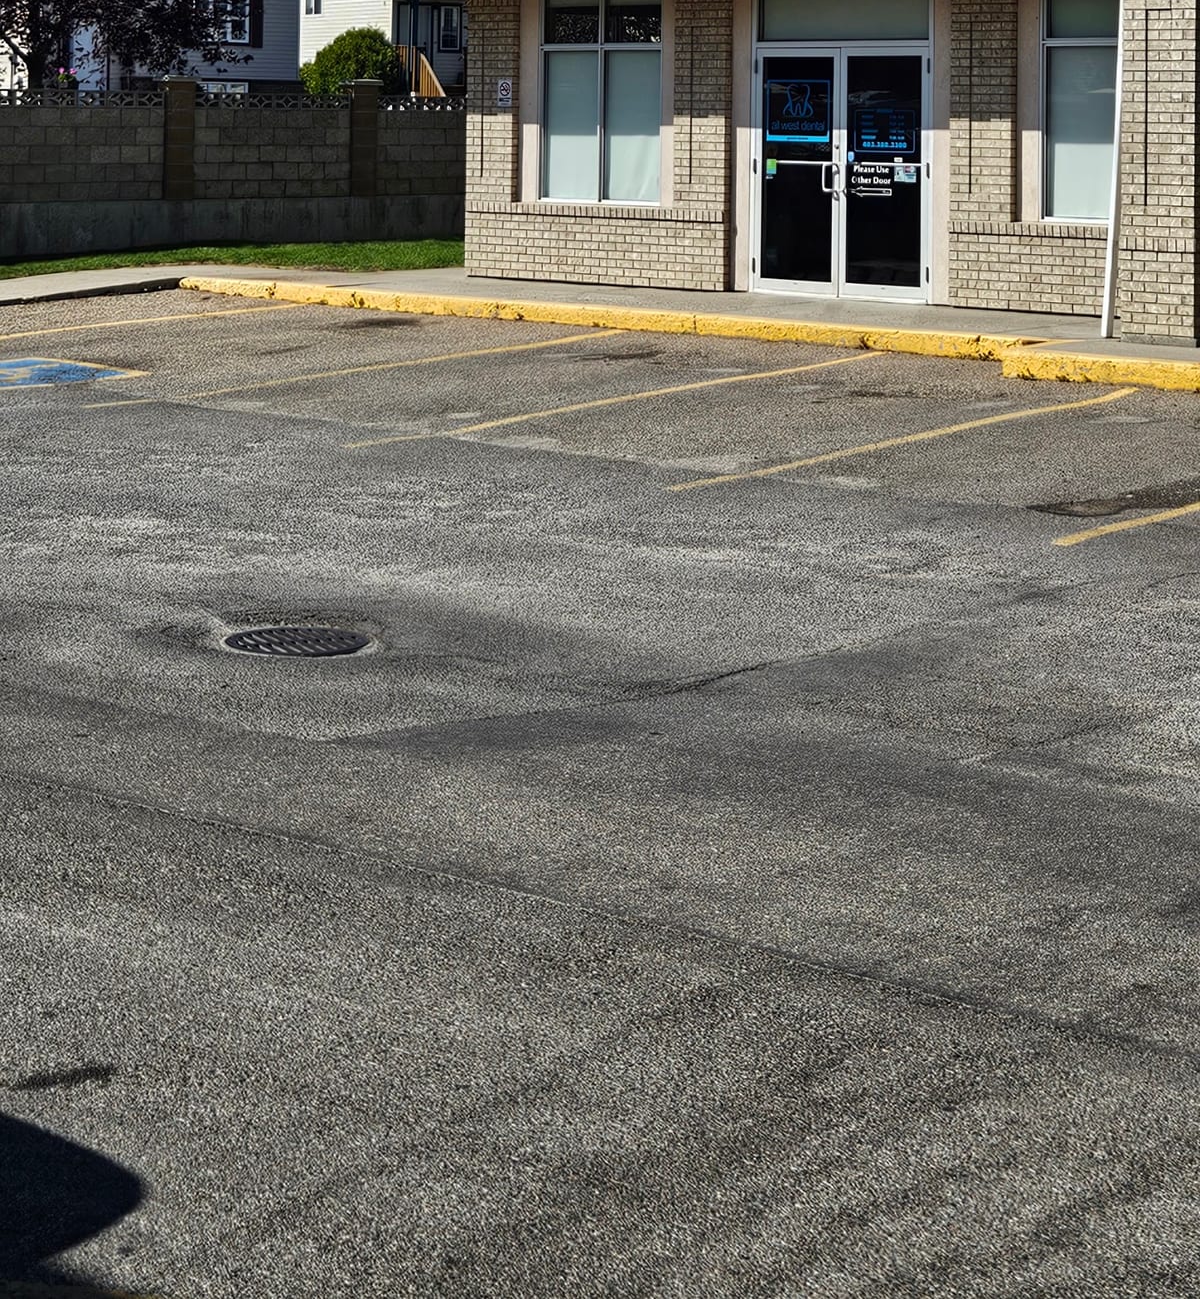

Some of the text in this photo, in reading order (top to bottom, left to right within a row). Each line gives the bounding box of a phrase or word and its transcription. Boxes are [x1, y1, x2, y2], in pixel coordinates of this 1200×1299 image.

[782, 120, 799, 130] west
[853, 165, 890, 174] Please Use
[851, 176, 892, 185] Other Door
